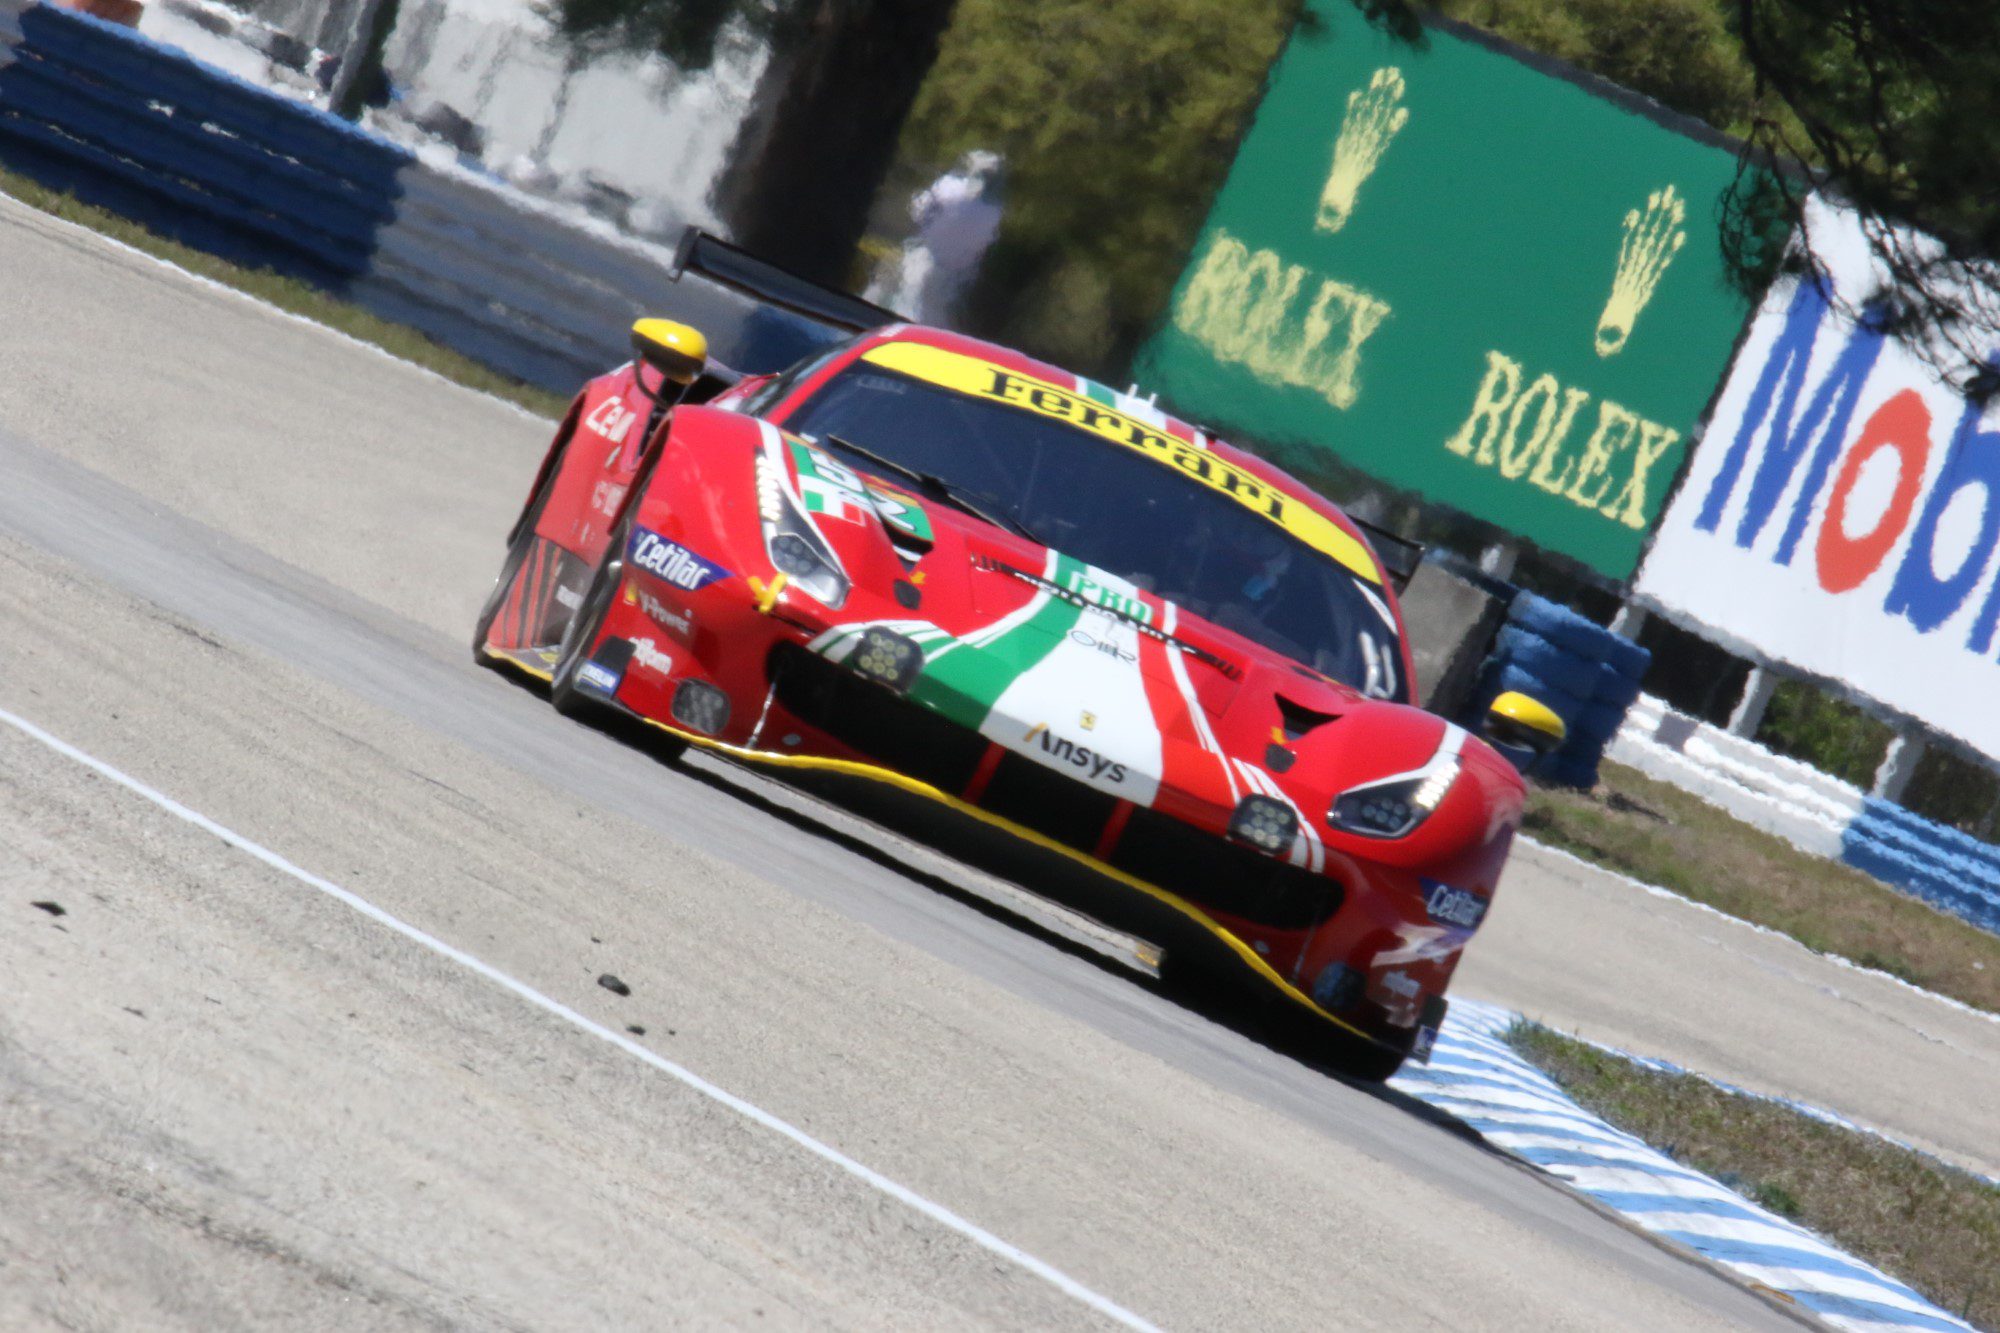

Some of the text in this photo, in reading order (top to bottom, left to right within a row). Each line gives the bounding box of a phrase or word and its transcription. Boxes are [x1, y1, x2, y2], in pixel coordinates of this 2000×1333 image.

[982, 368, 1287, 524] Ferrari
[1445, 350, 1680, 530] ROLEX
[1694, 277, 2000, 660] Mob
[634, 533, 711, 590] Cetilar
[1074, 577, 1149, 623] PRO
[1023, 722, 1127, 783] Ansys
